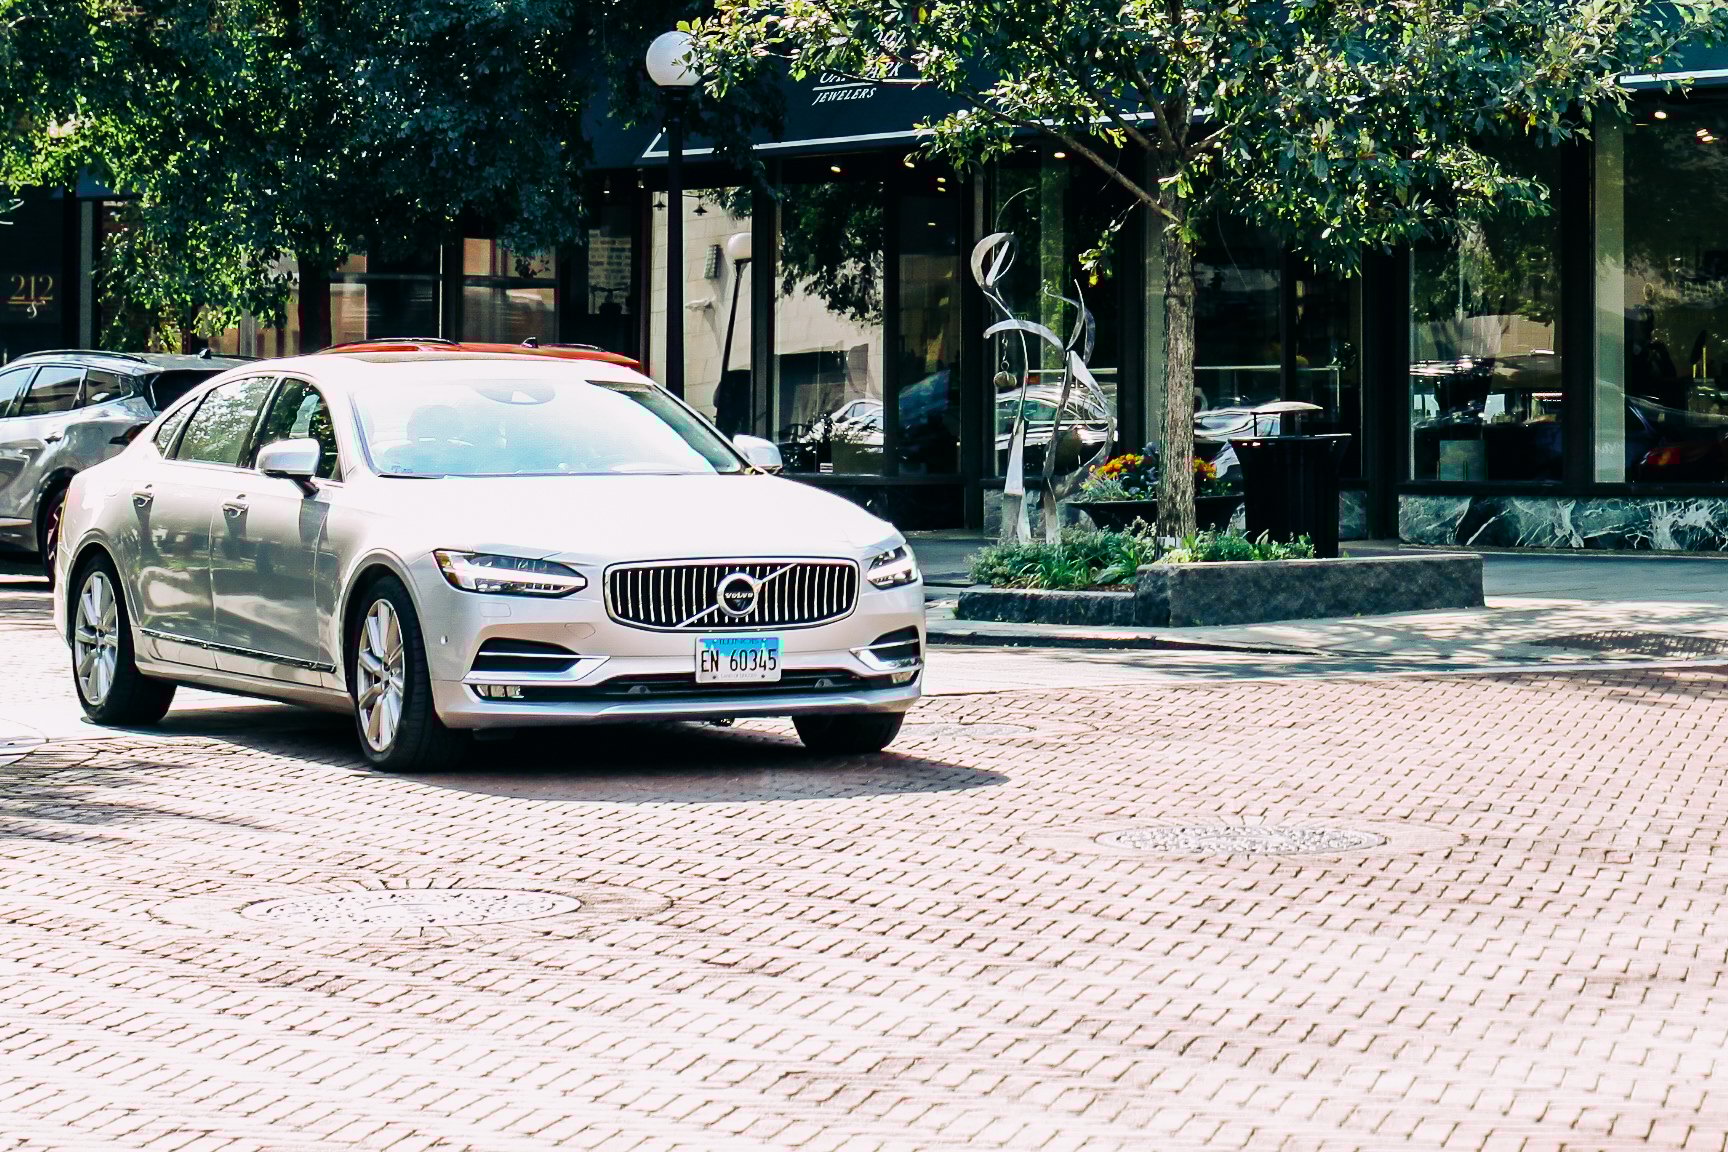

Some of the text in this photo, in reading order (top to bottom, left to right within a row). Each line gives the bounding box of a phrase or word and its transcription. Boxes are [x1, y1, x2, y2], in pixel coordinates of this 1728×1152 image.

[811, 87, 877, 106] JEWELERS
[10, 274, 53, 300] 212
[701, 648, 777, 672] EN 60345
